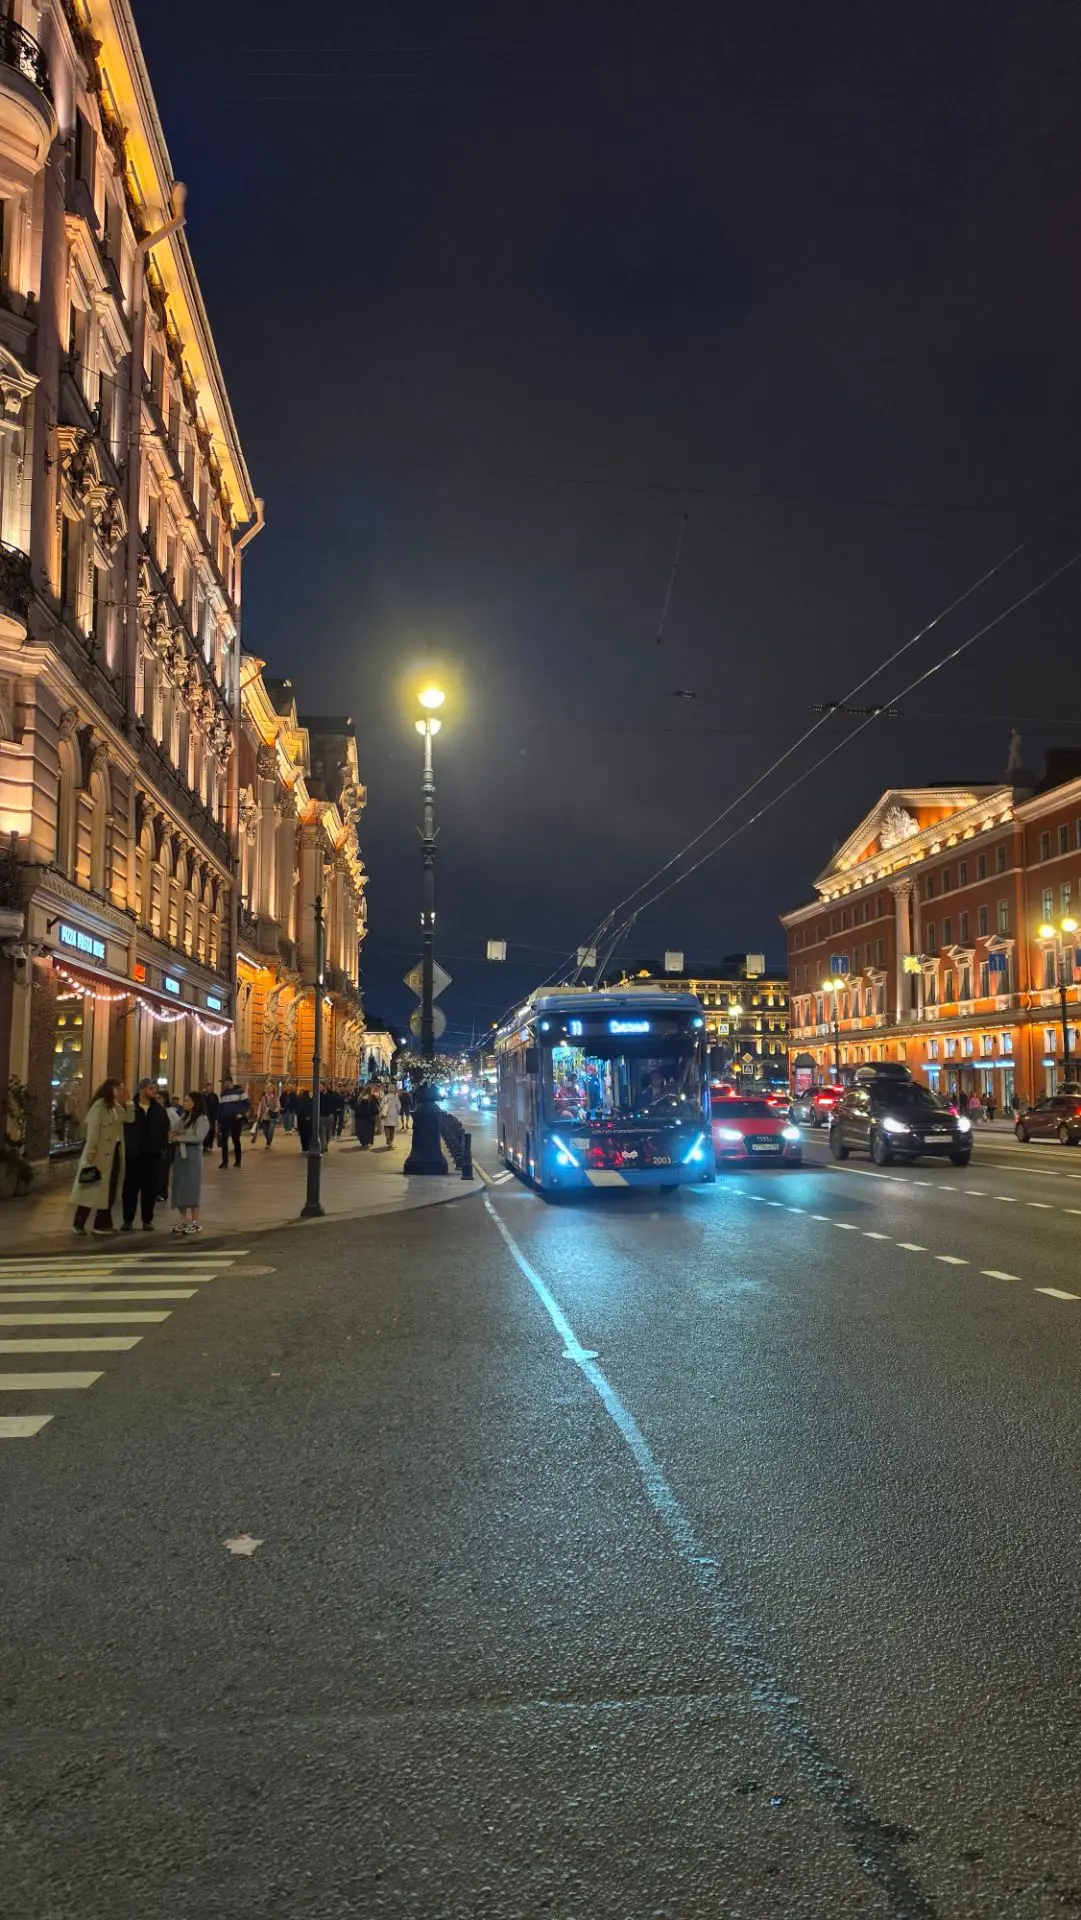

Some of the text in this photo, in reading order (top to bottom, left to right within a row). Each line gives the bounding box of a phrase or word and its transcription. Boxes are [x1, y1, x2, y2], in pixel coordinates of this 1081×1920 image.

[61, 925, 77, 946] PIZZA
[77, 931, 93, 954] PASTA
[652, 1156, 672, 1165] 2003
